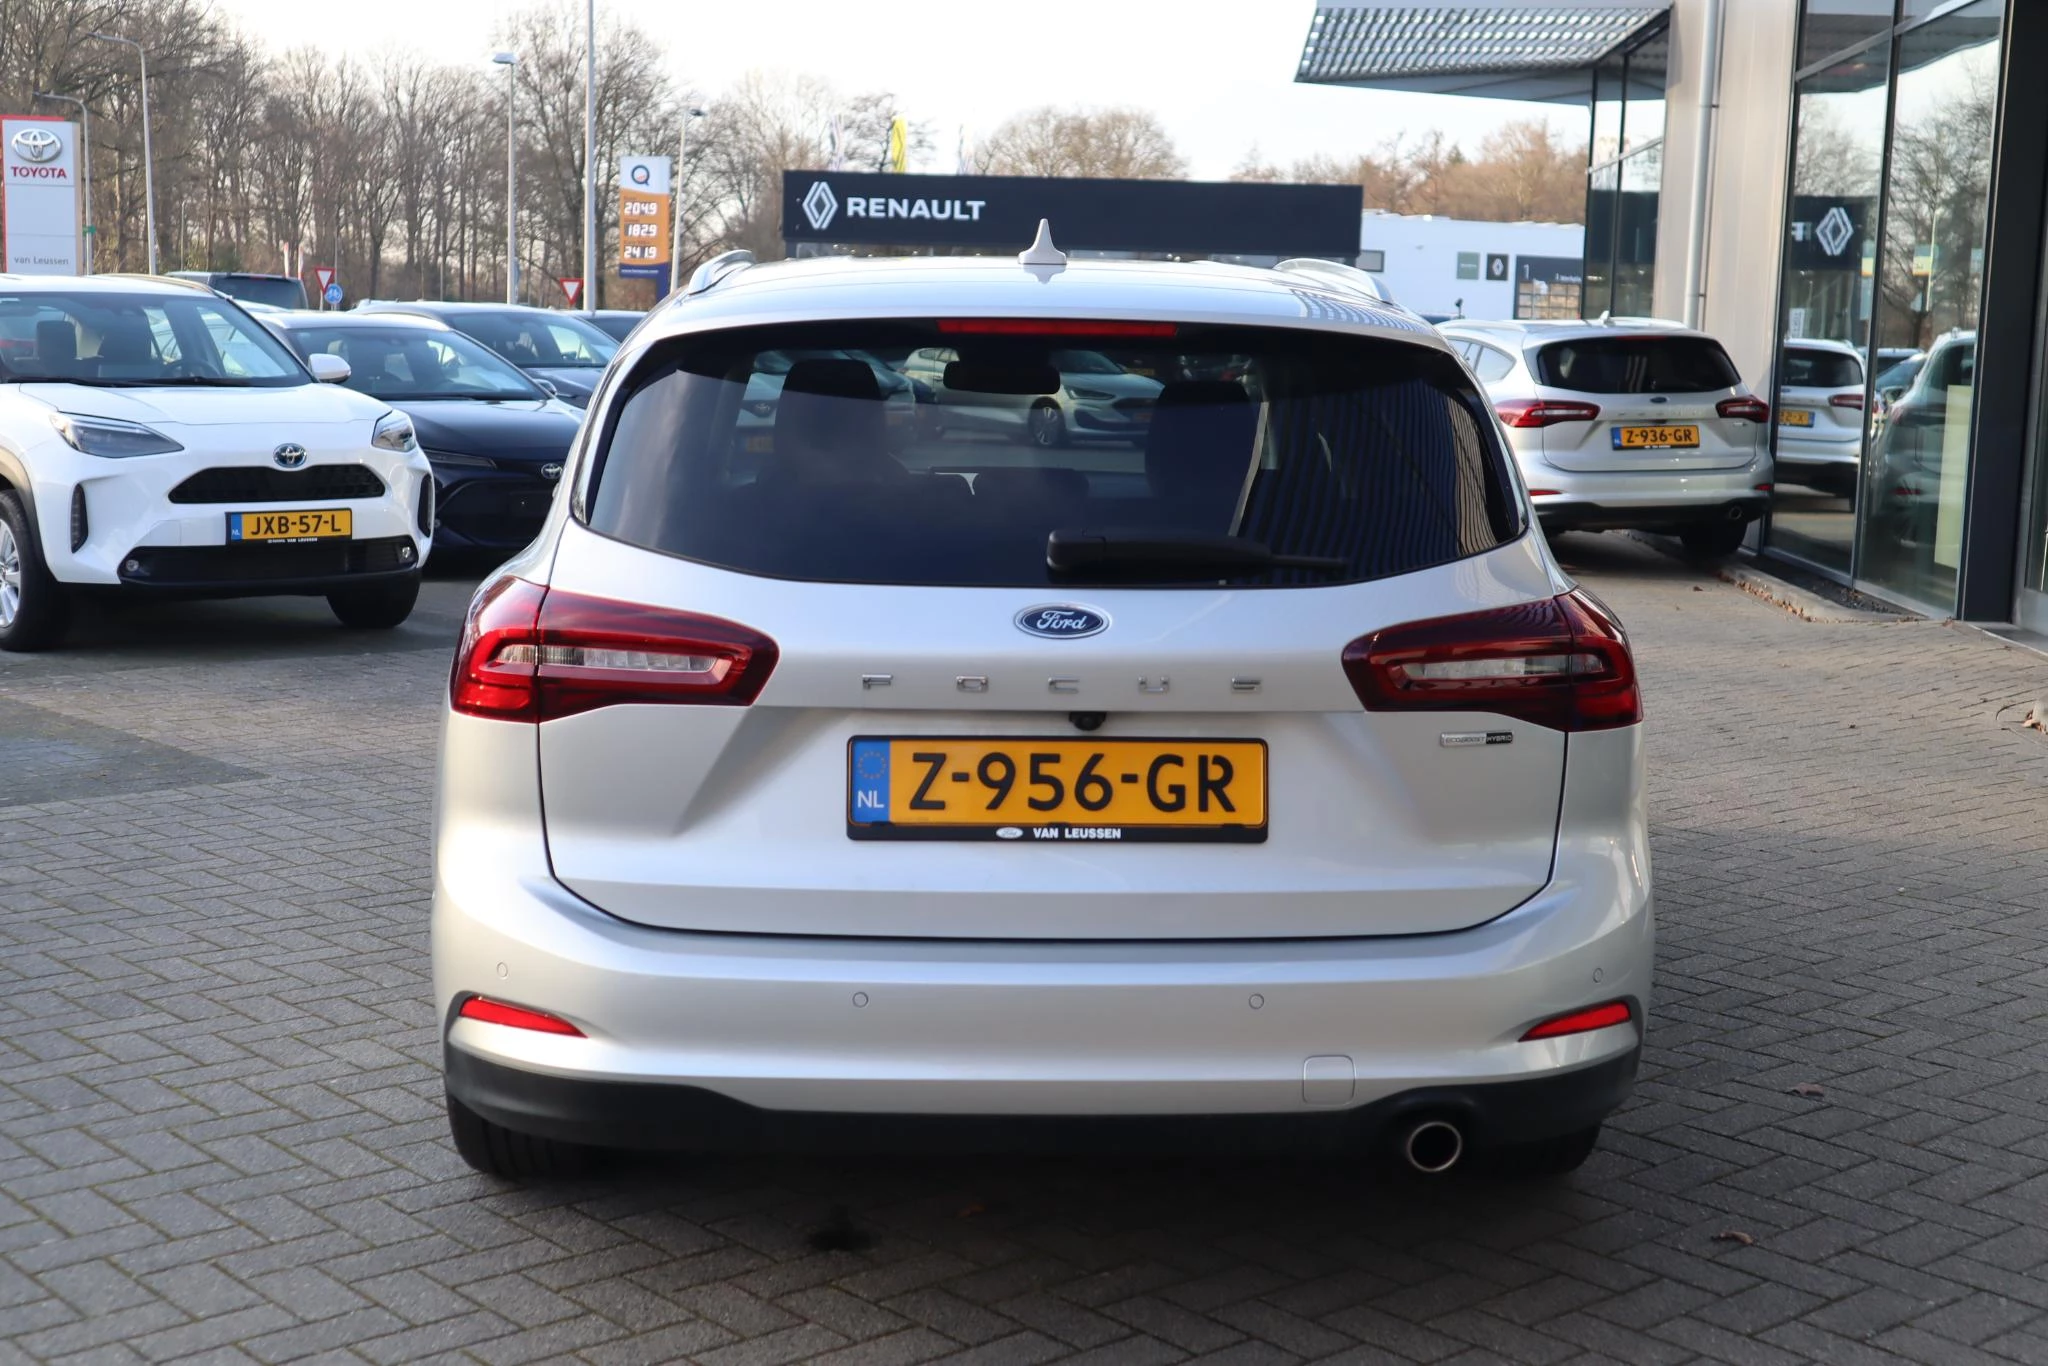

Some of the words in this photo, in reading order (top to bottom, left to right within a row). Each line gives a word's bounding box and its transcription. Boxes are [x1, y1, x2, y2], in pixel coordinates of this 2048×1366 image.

[10, 166, 67, 179] TOYOTA
[847, 197, 986, 221] RENAULT
[14, 257, 30, 265] van
[33, 255, 69, 266] Leussen
[1626, 428, 1693, 443] Z-936-GR
[250, 513, 342, 536] JXB-57-L
[1036, 609, 1088, 631] Ford
[862, 673, 1262, 692] FOCUS
[1486, 734, 1513, 743] HYBRID
[909, 752, 1237, 813] Z-956-GR
[856, 789, 885, 809] NL
[1033, 828, 1059, 839] VAN
[1065, 827, 1122, 839] LEUSSEN
